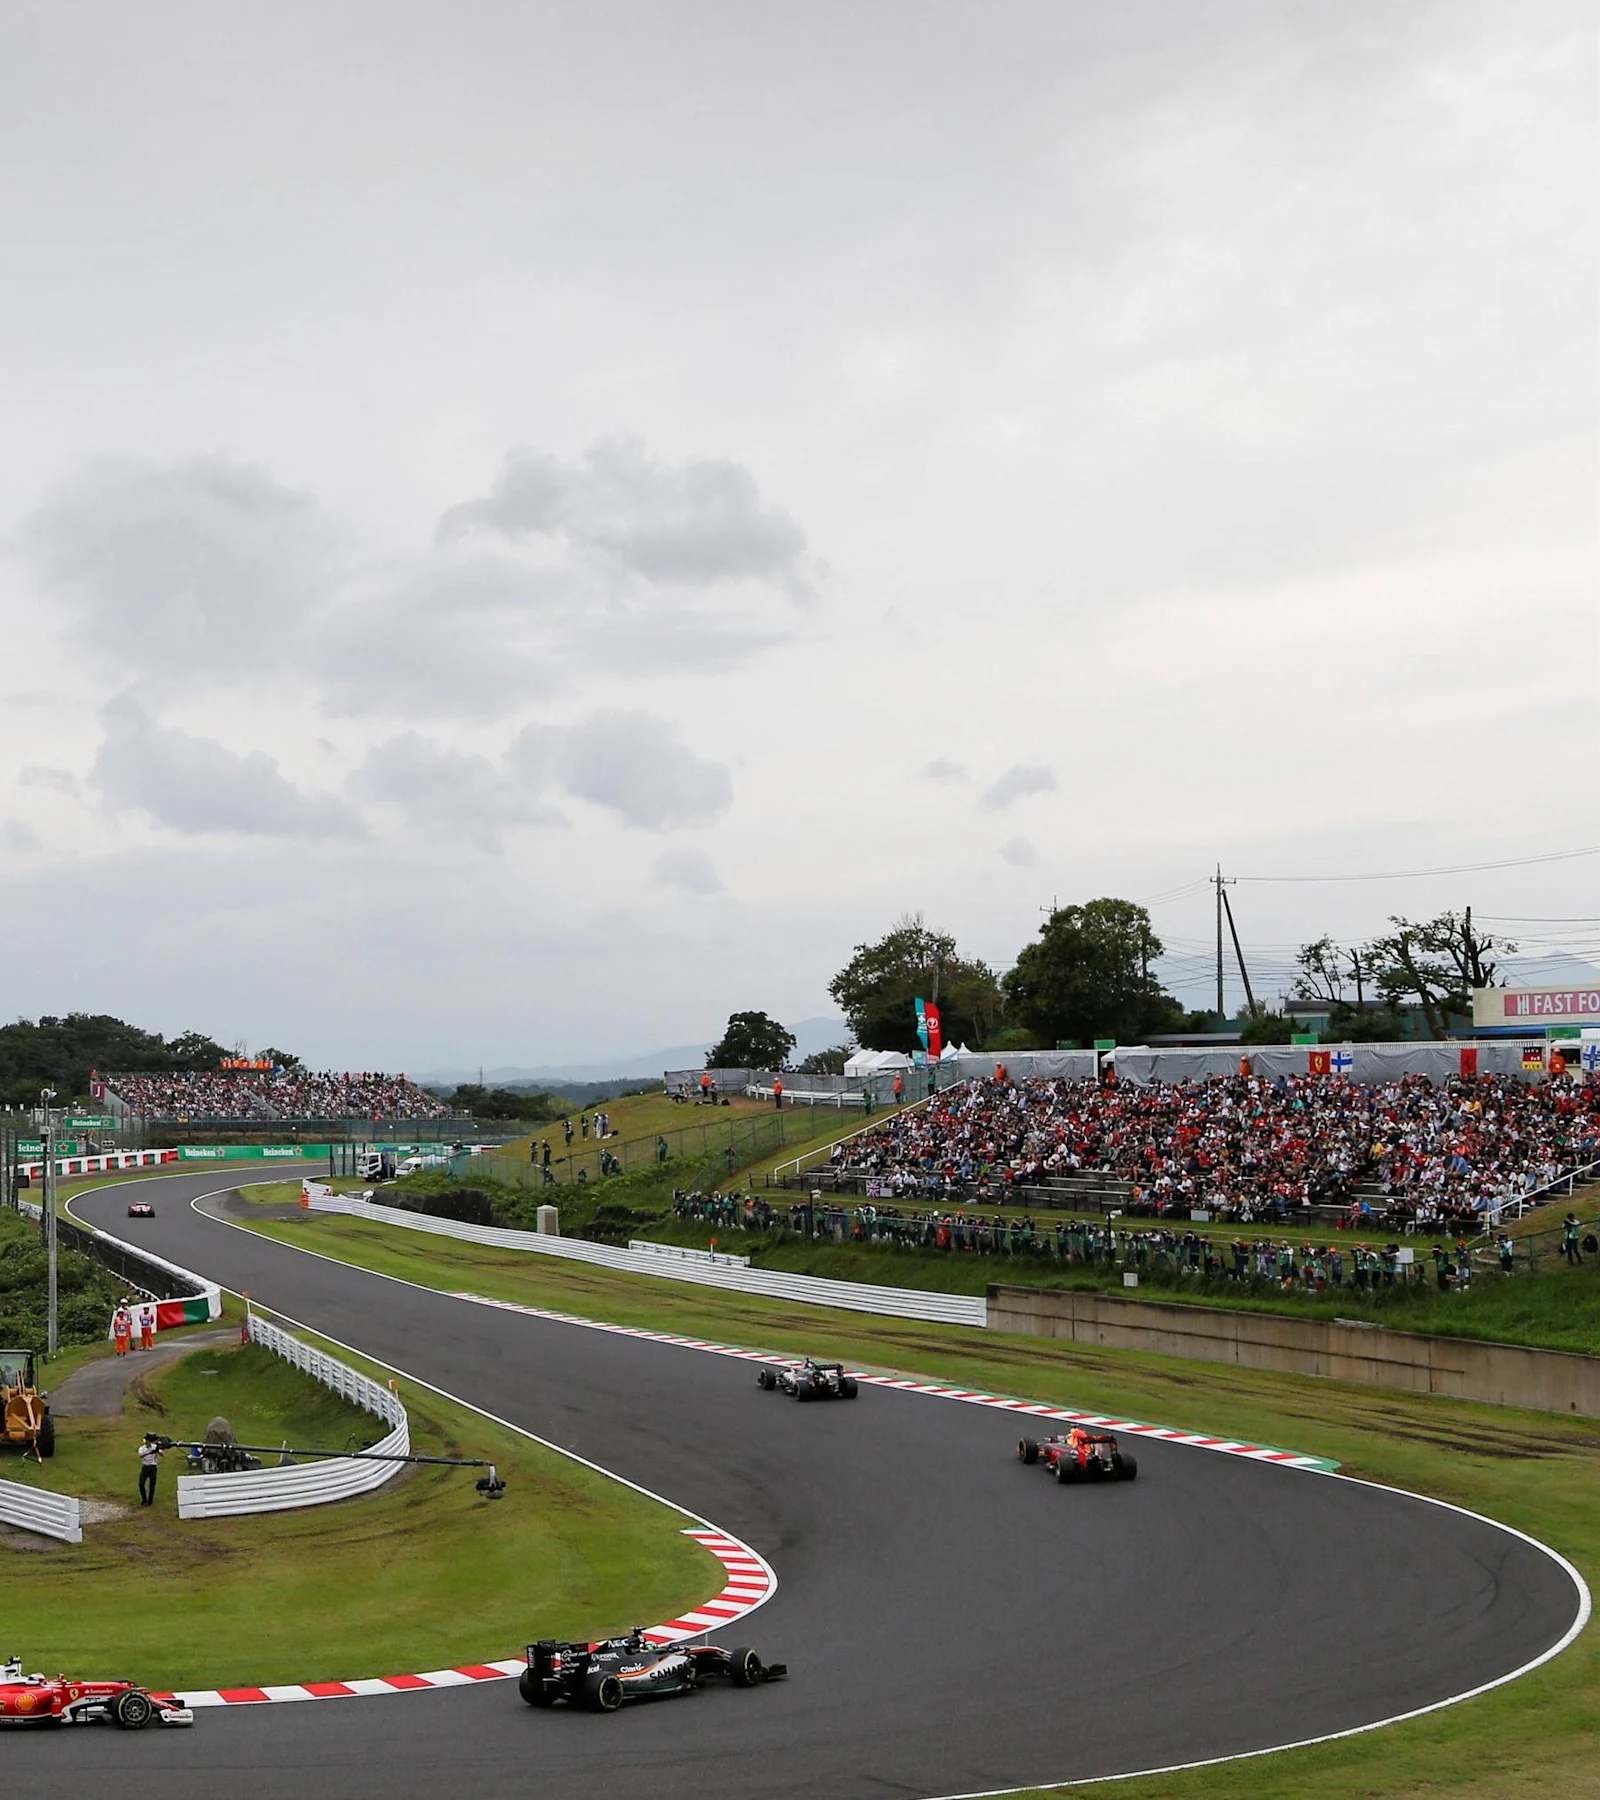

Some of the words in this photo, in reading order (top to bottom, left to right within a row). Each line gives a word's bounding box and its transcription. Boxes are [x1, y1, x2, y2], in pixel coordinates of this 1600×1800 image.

[1533, 993, 1574, 1014] FAST
[1578, 992, 1600, 1012] FO
[95, 1083, 101, 1098] J
[72, 1119, 101, 1127] Heineken
[185, 1148, 216, 1157] Heineken
[263, 1148, 294, 1156] Heineken
[607, 1638, 630, 1648] NEC
